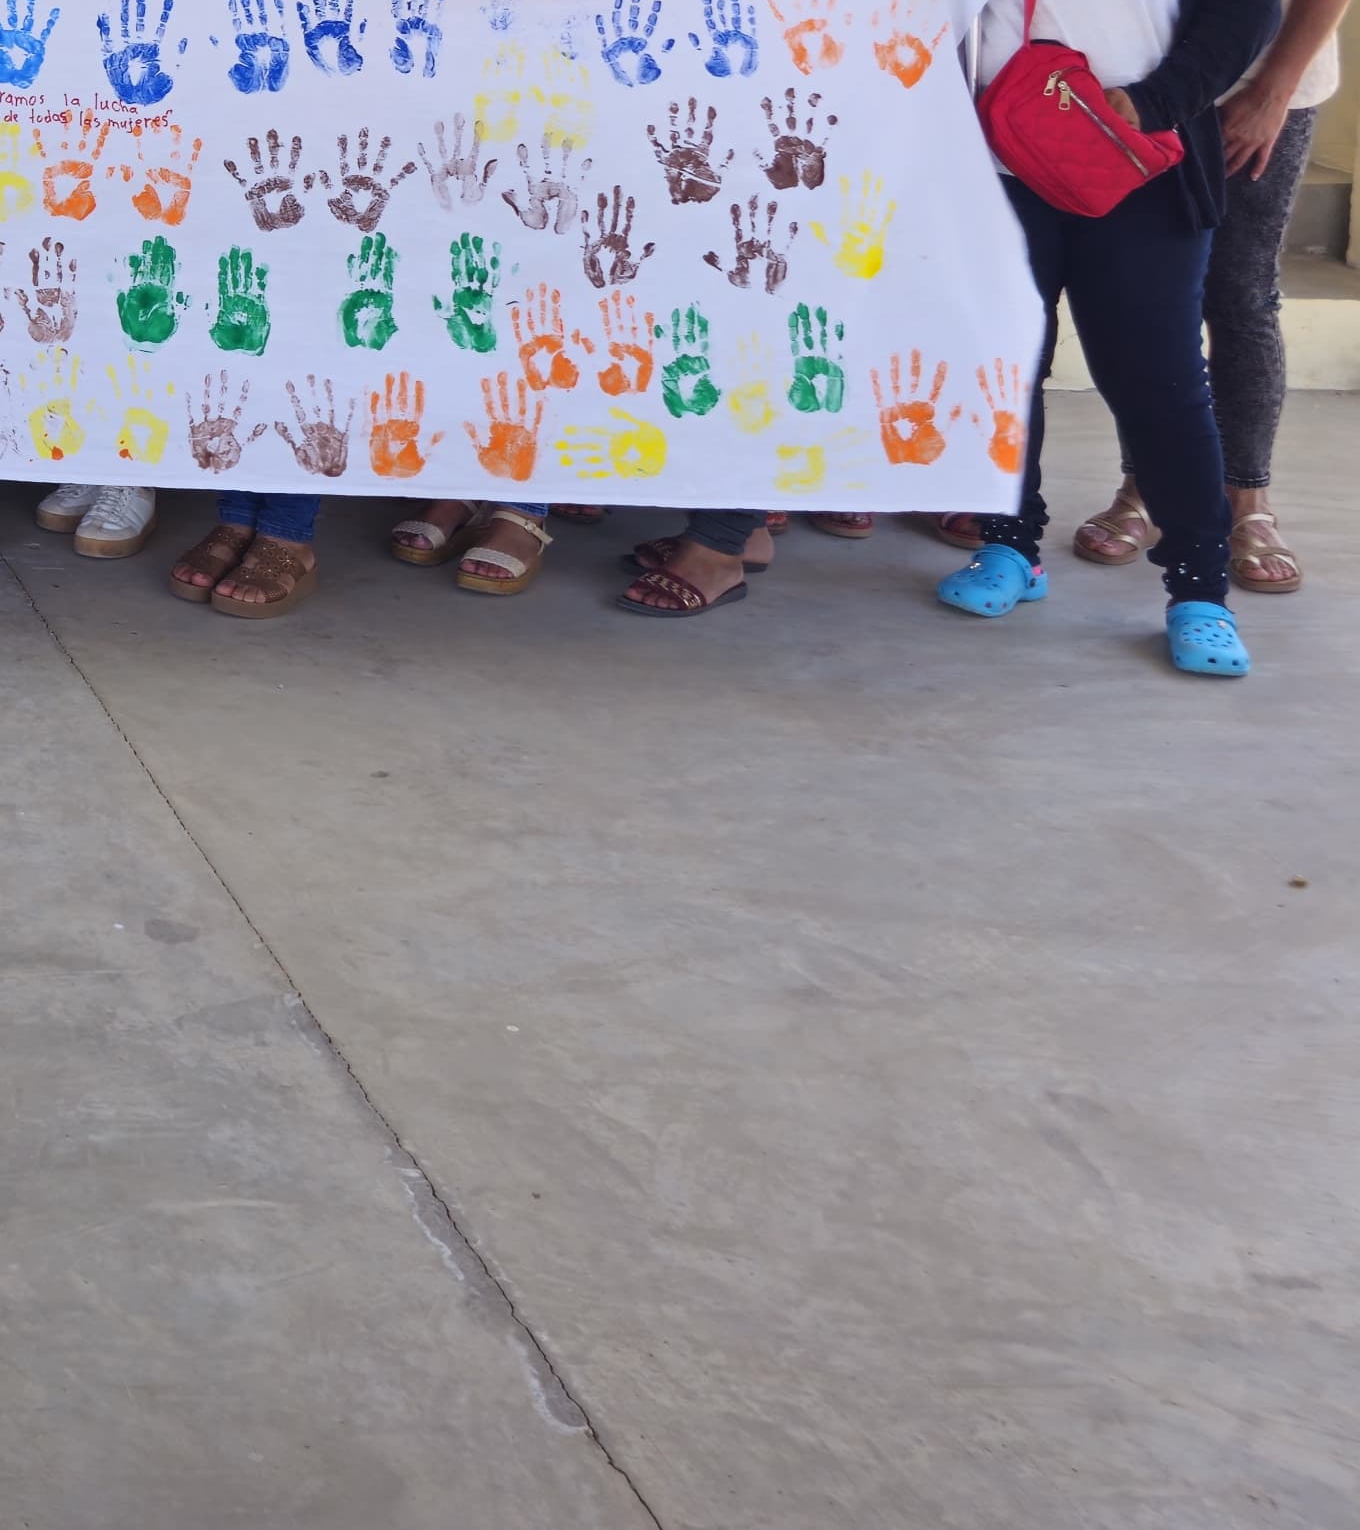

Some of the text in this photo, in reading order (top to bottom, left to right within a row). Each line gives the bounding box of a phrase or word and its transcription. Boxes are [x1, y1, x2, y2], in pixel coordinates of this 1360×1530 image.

[63, 93, 81, 108] la
[94, 92, 139, 115] lucha
[3, 109, 19, 124] de
[28, 107, 68, 125] todas
[79, 110, 102, 129] las
